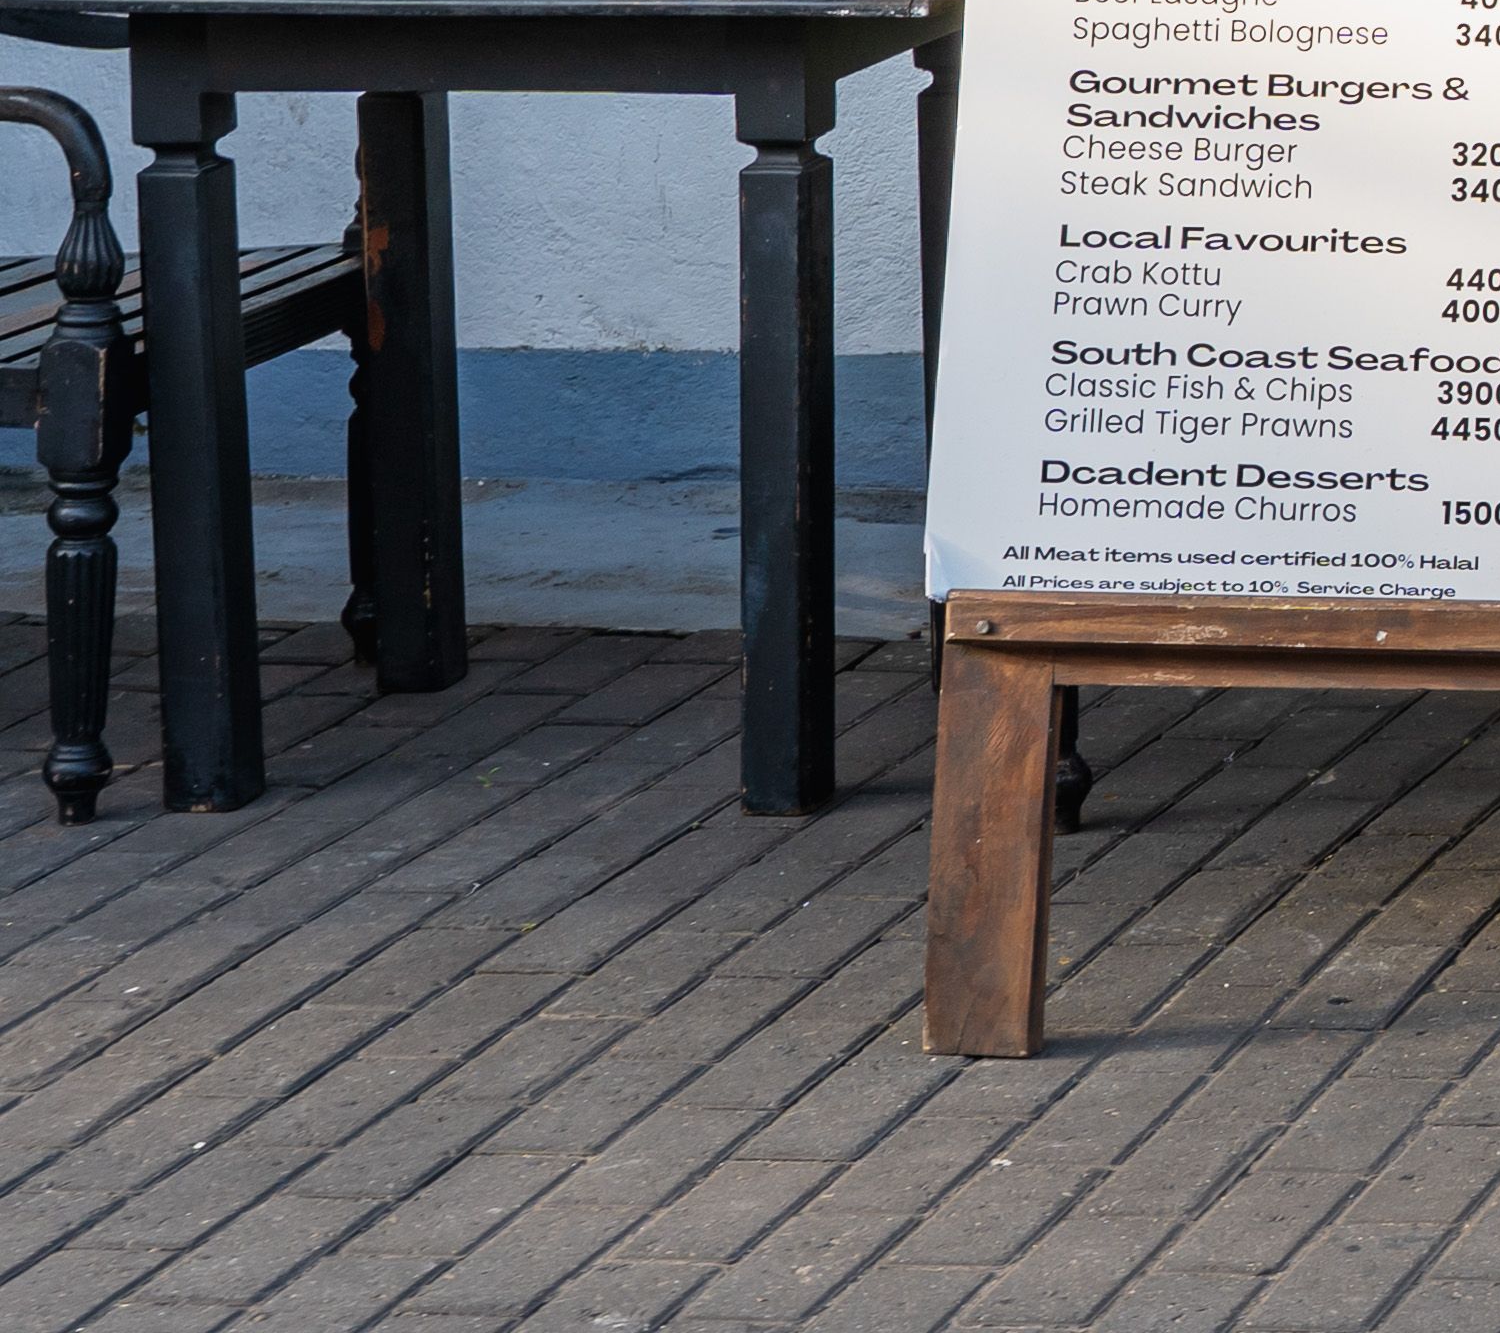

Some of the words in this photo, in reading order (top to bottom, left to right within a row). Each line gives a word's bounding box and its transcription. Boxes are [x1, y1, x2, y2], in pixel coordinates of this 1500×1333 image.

[1073, 16, 1220, 49] Spaghetti
[1231, 19, 1388, 52] Bolognese
[1069, 69, 1259, 97] Gourmet
[1267, 73, 1433, 105] Burgers
[1442, 77, 1469, 101] &
[1066, 103, 1321, 132] Sandwiches
[1060, 224, 1172, 250] Local
[1180, 226, 1407, 255] Favourites
[1051, 340, 1177, 366] South
[1186, 343, 1319, 370] Coast
[1045, 372, 1156, 399] Classic
[1166, 373, 1224, 400] Fish
[1234, 376, 1255, 401] &
[1265, 376, 1353, 411] Chips
[1044, 407, 1145, 434] Grilled
[1155, 409, 1232, 444] Tiger
[1241, 412, 1353, 439] Prawns
[1040, 459, 1227, 488] Dcadent
[1236, 463, 1430, 492] Desserts
[1002, 545, 1030, 560] All
[1034, 546, 1100, 562] Meat
[1104, 546, 1173, 564] items
[1177, 550, 1236, 565] used
[1240, 551, 1347, 567] certified
[1350, 553, 1415, 569] 100%
[1419, 554, 1479, 571] Halal
[1002, 575, 1026, 588] All
[1029, 575, 1095, 590] Prices
[1098, 580, 1135, 590] are
[1140, 578, 1217, 594] subject
[1220, 580, 1245, 593] to
[1248, 580, 1289, 594] 10%
[1296, 581, 1375, 596] Service
[1379, 583, 1456, 600] Charge
